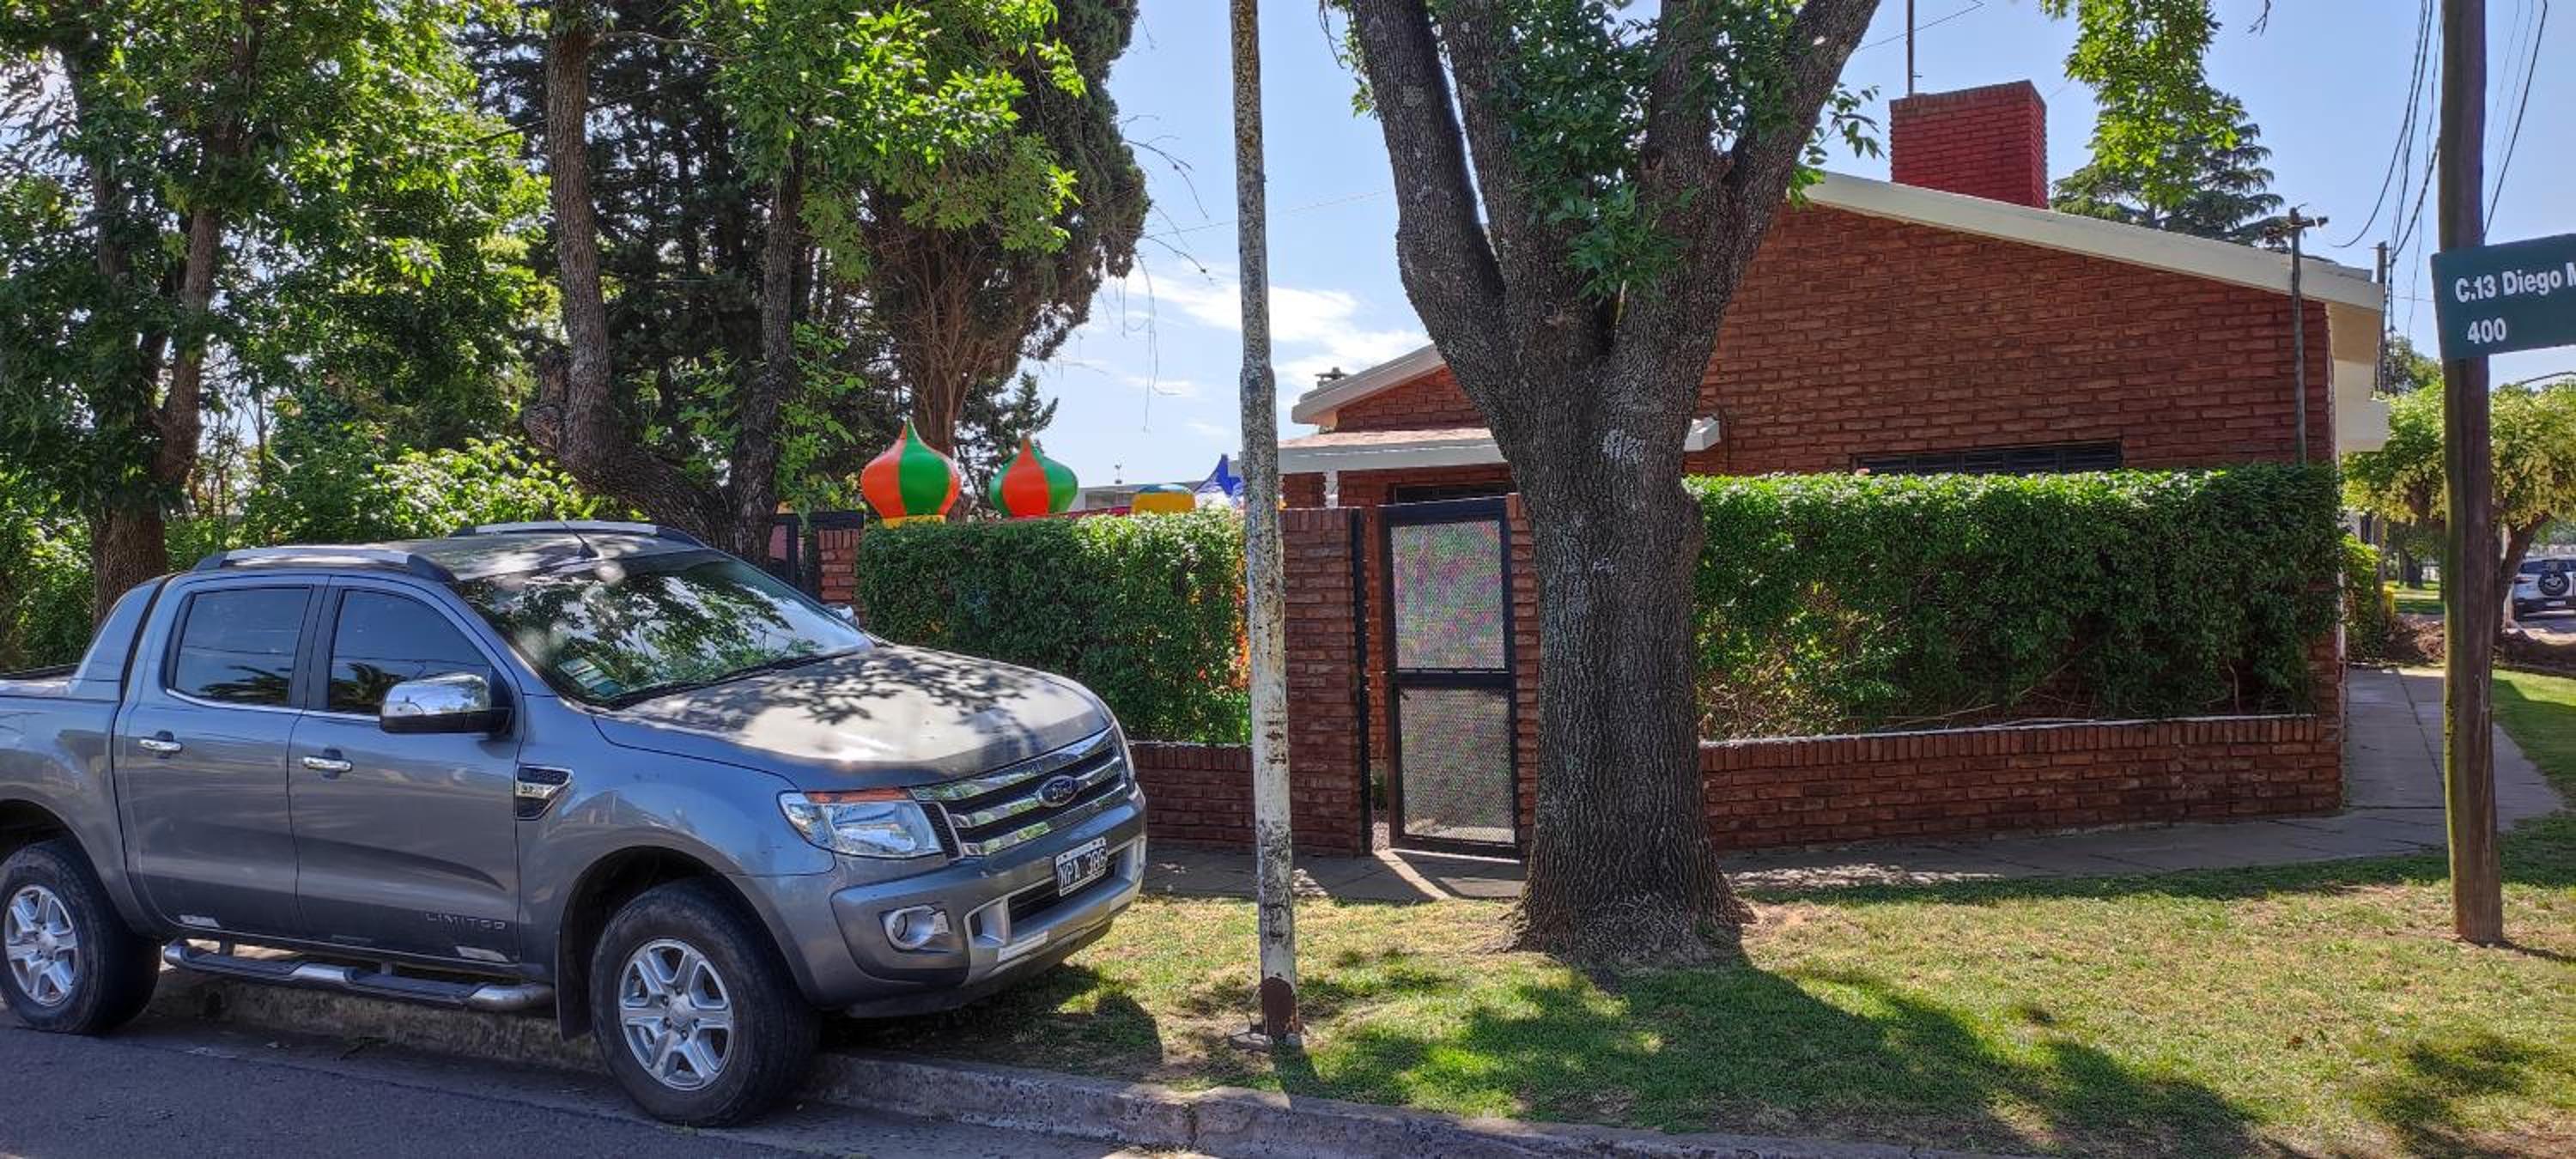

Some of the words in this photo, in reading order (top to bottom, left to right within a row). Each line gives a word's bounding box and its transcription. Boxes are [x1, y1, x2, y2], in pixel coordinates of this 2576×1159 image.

[2455, 275, 2496, 302] C.13
[2501, 269, 2561, 296] Diego
[2467, 318, 2506, 343] 400
